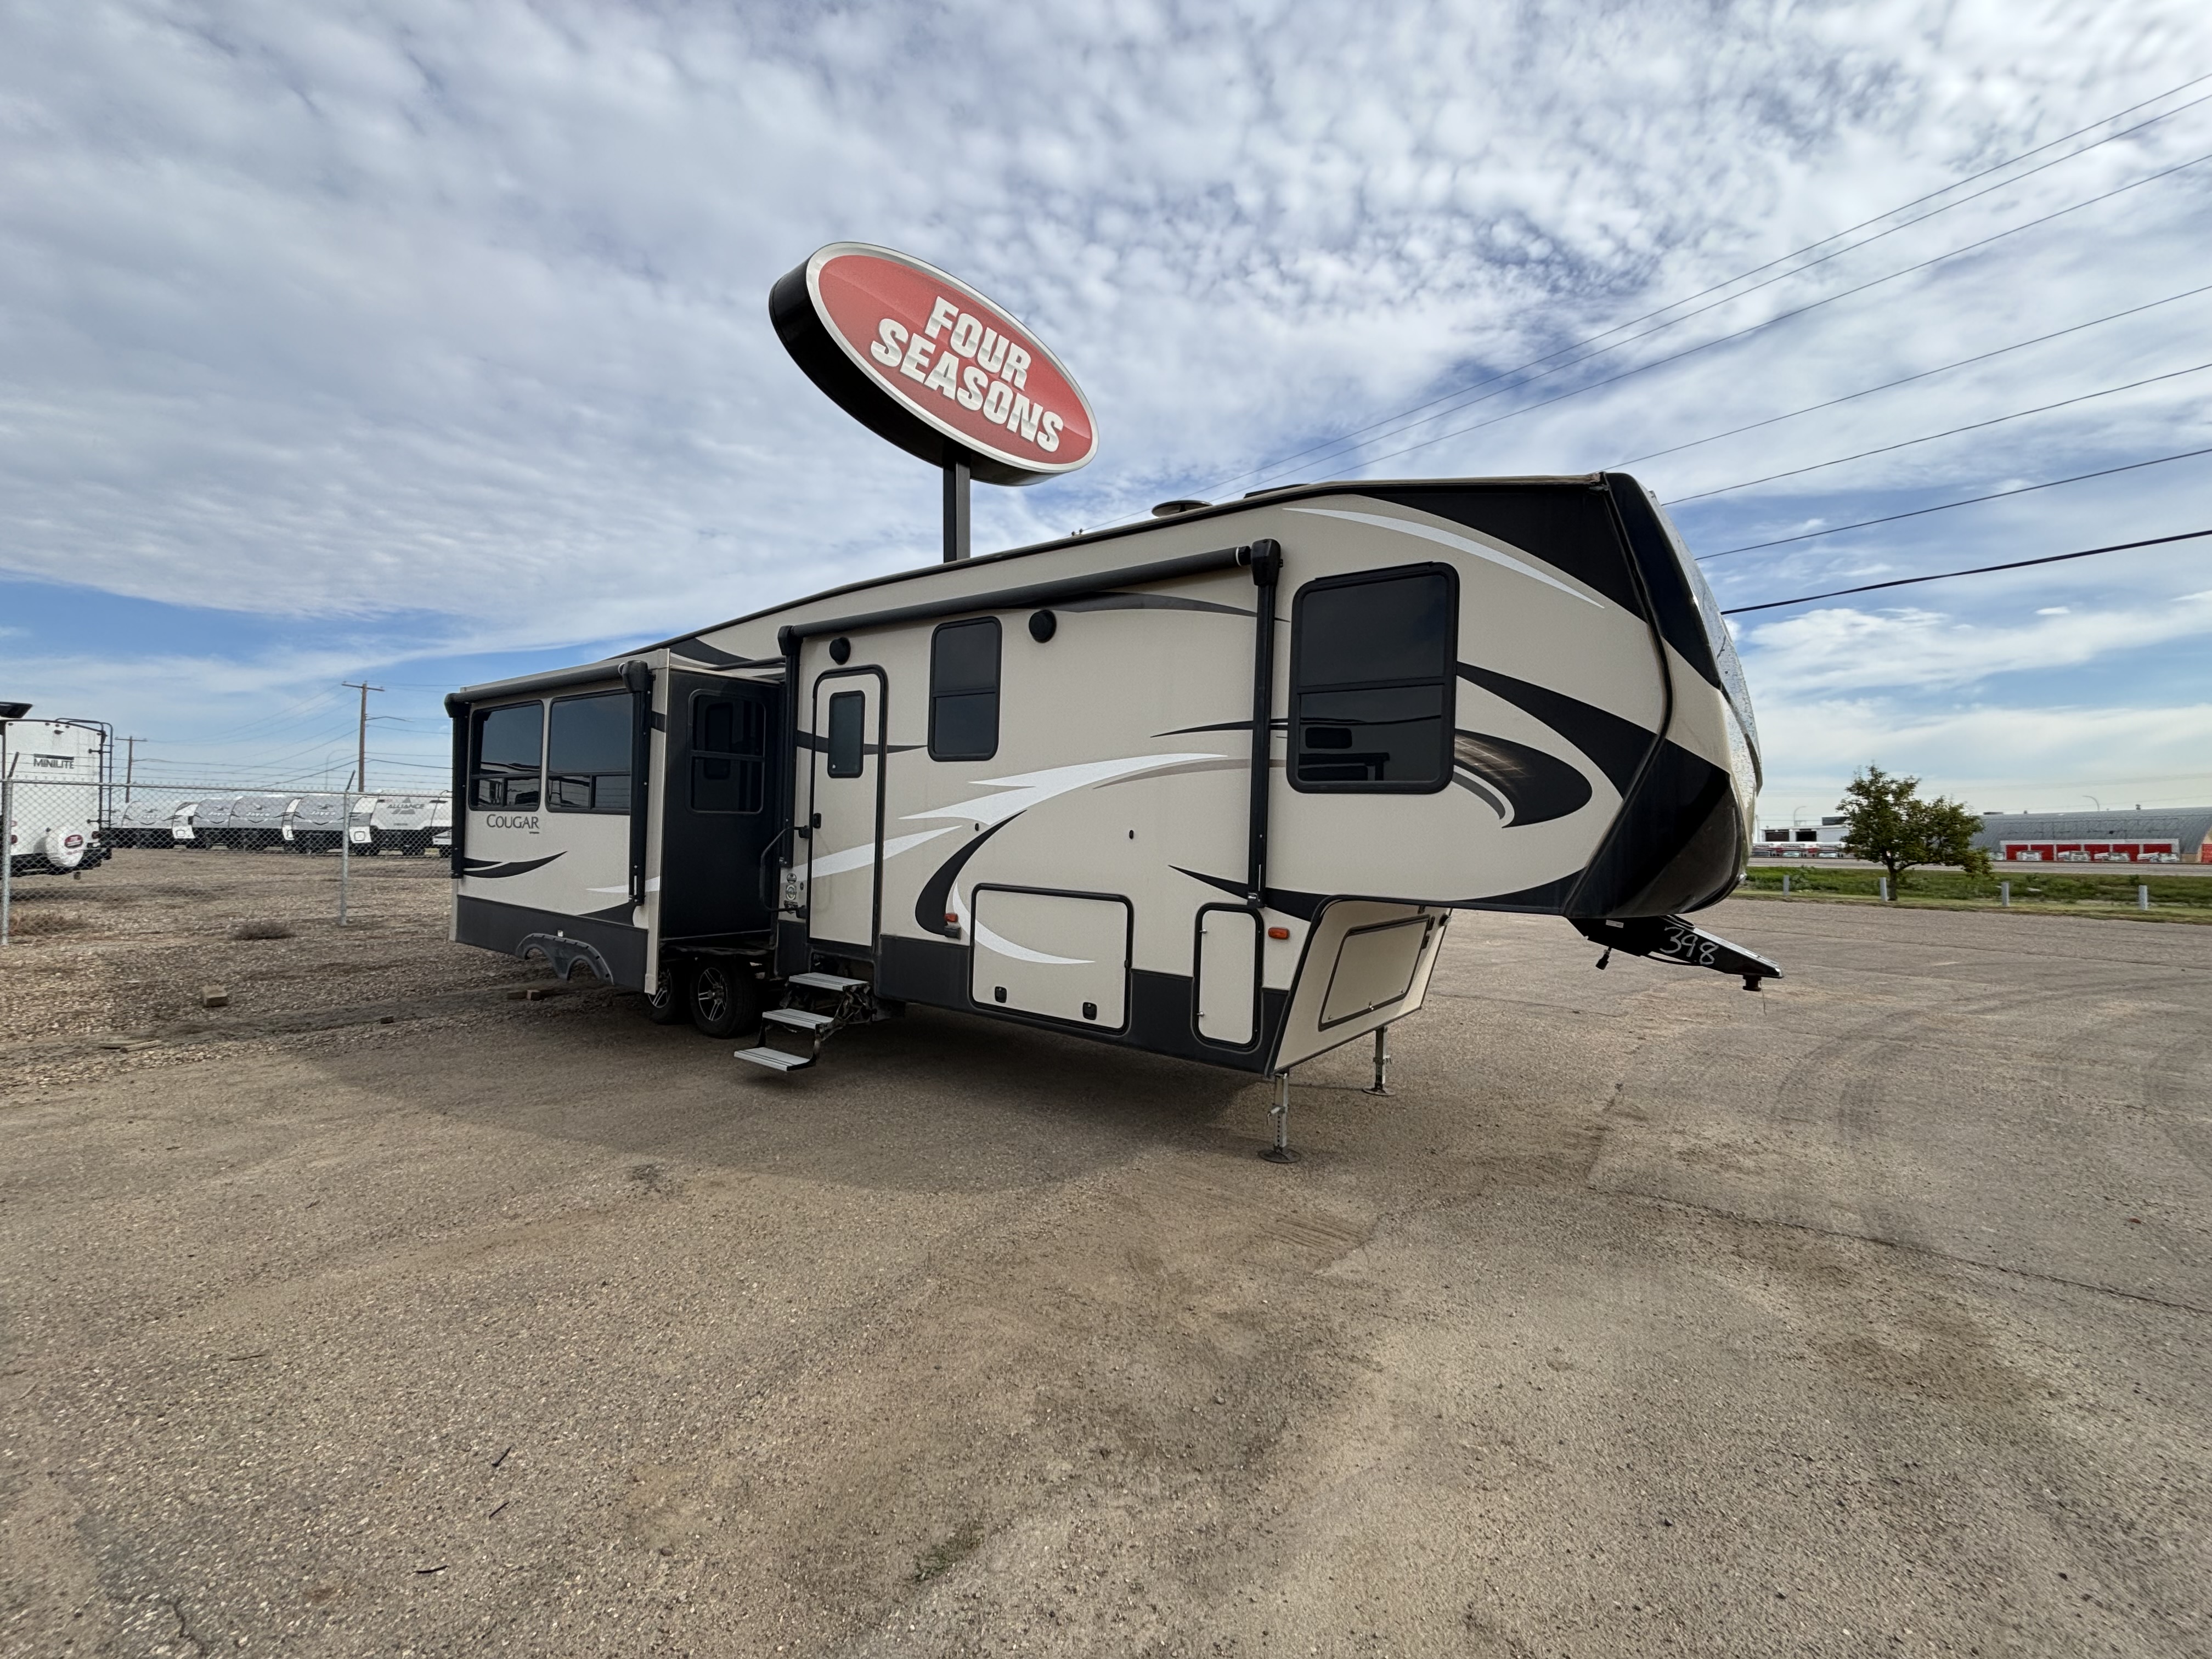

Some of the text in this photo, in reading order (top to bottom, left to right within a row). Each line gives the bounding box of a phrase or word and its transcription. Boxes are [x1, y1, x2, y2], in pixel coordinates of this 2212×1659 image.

[924, 296, 1031, 391] FOUR
[871, 318, 1063, 452] SEASONS
[487, 814, 540, 829] COUGAR
[1659, 926, 1719, 966] 398
